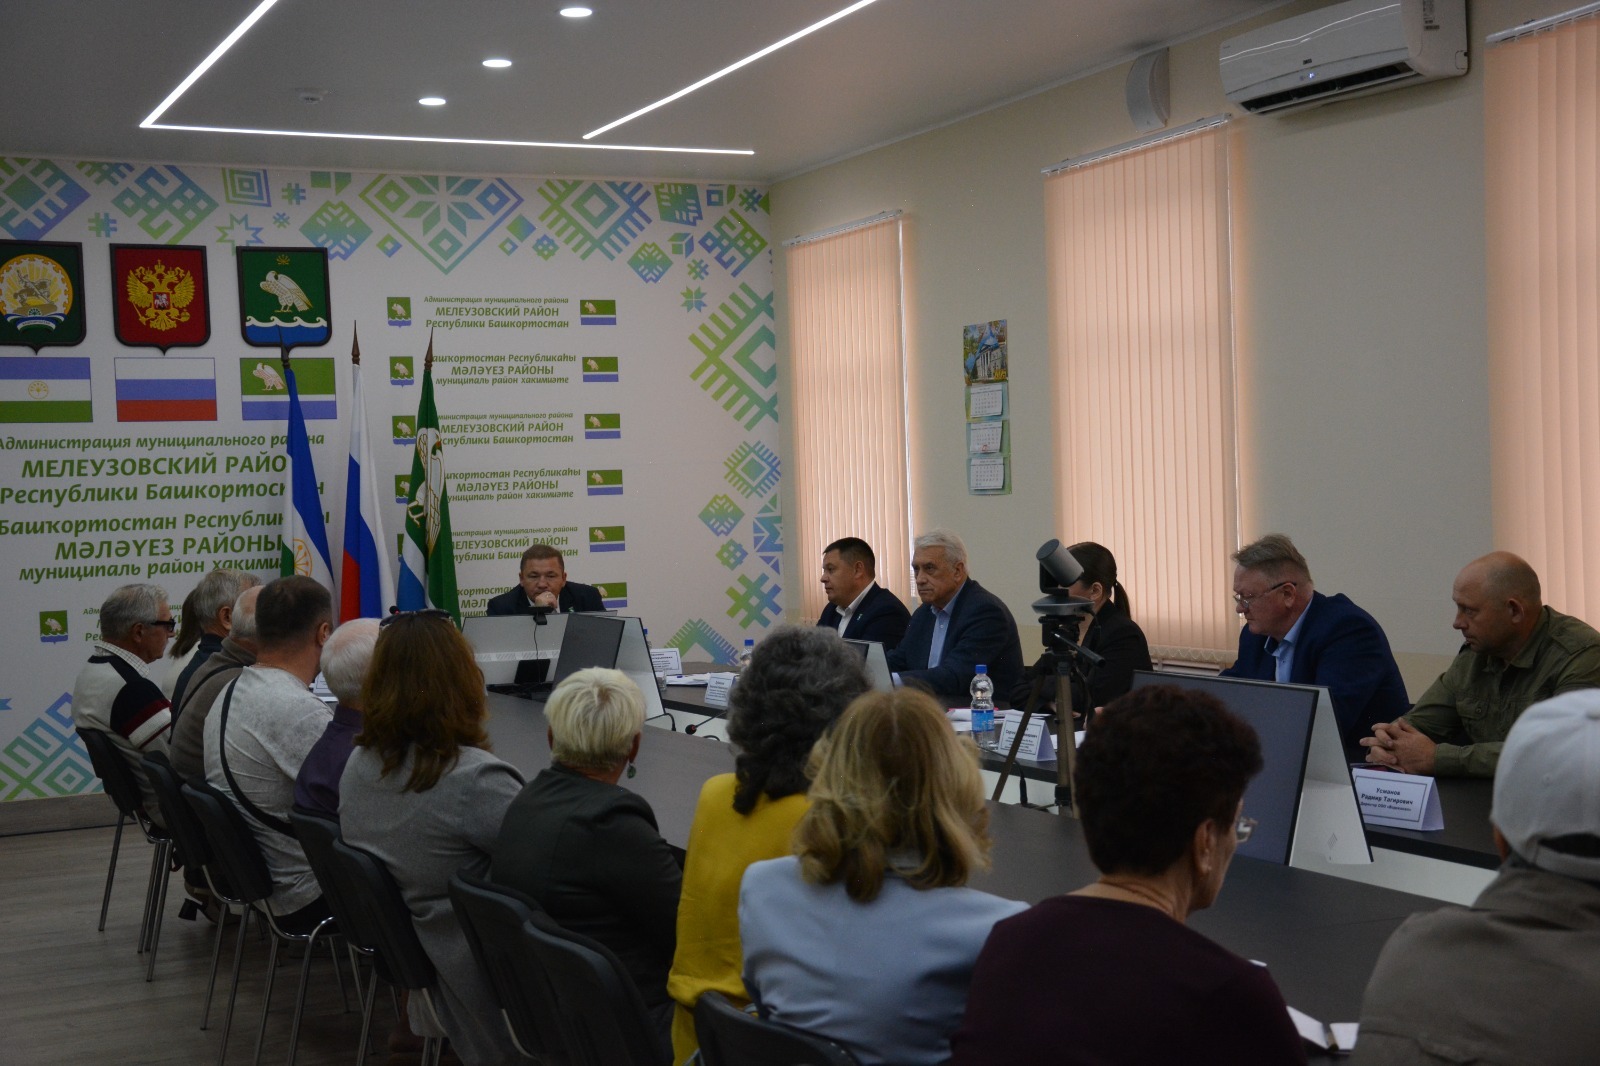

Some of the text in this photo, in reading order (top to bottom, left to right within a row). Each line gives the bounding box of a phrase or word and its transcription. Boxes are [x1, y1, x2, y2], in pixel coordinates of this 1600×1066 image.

[424, 296, 482, 304] Администрация
[544, 296, 568, 304] района
[436, 306, 559, 316] МЕЛЕУЗОВСКИЙ РАЙОН
[426, 318, 568, 330] Республики Башкортостан
[432, 354, 506, 364] ашҡортостан
[508, 364, 554, 374] РАЙОНЫ
[436, 377, 490, 386] муниципаль
[492, 376, 518, 386] район
[489, 412, 546, 420] муниципального
[548, 412, 574, 420] района
[441, 420, 564, 434] МЕЛЕУЗОВСКИЙ РАЙОН
[136, 435, 266, 451] муниципального
[270, 434, 324, 448] рана
[442, 435, 574, 448] спублики Башкортостан
[22, 450, 287, 478] МЕЛЕУЗОВСКИЙ РАЙО
[512, 479, 558, 490] РАЙОНЫ
[1, 484, 138, 508] Республики
[448, 494, 494, 504] униципаль
[496, 492, 522, 502] район
[494, 528, 551, 536] муниципального
[553, 526, 578, 534] района
[183, 532, 282, 554] РАЙОНЫ
[533, 534, 568, 546] РАЙОН
[19, 564, 140, 584] муниципаль
[148, 558, 204, 578] район
[1376, 788, 1400, 796] Усманов
[1384, 796, 1414, 804] Тагирович
